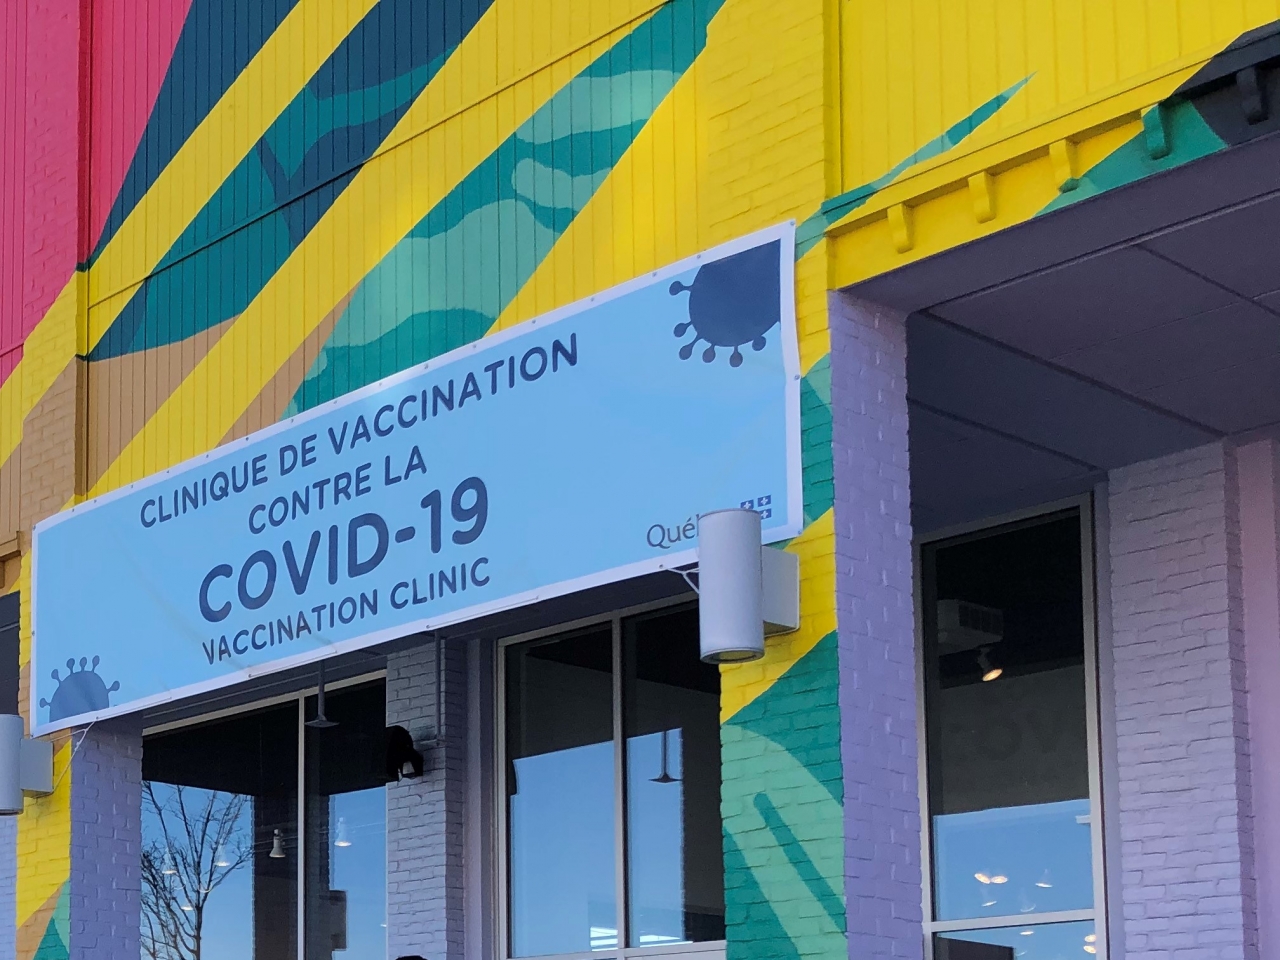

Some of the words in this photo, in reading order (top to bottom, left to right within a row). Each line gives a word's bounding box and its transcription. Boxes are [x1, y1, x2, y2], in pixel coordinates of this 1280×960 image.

[140, 453, 269, 529] CLINIQUE
[279, 433, 318, 477] DE
[327, 332, 578, 456] VACCINATION
[248, 462, 372, 535] CONTRE
[384, 445, 428, 486] LA
[646, 513, 700, 550] Qué
[198, 476, 489, 623] COVID-19
[202, 588, 379, 666] VACCINATION
[389, 557, 491, 610] CLINIC
